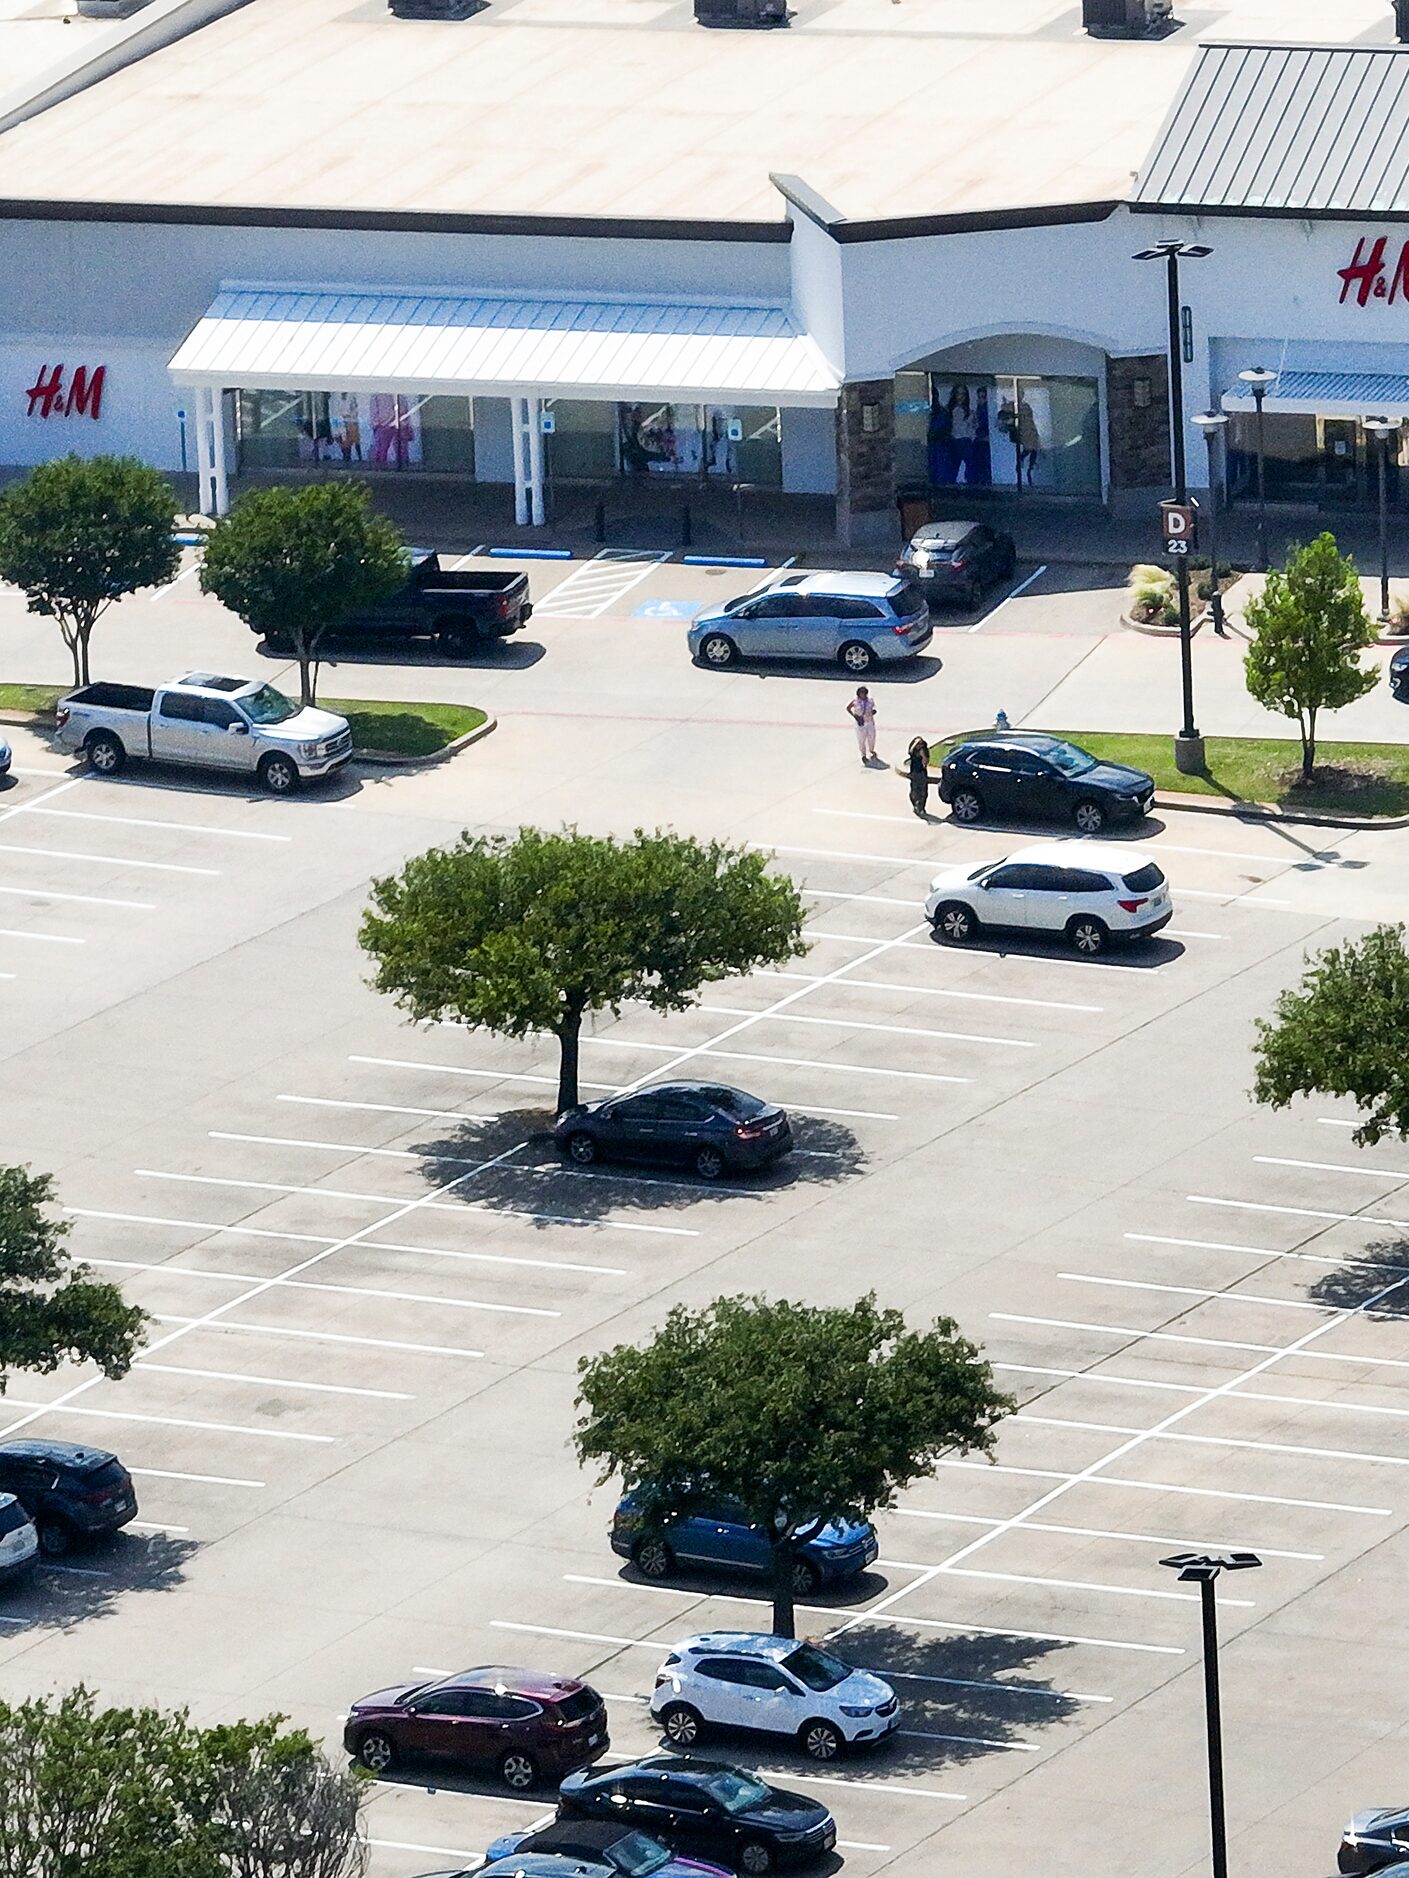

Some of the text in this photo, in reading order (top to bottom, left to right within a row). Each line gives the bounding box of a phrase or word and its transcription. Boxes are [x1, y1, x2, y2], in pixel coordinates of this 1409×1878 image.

[26, 364, 105, 420] H&M
[1168, 512, 1185, 534] D
[1167, 539, 1187, 554] 23
